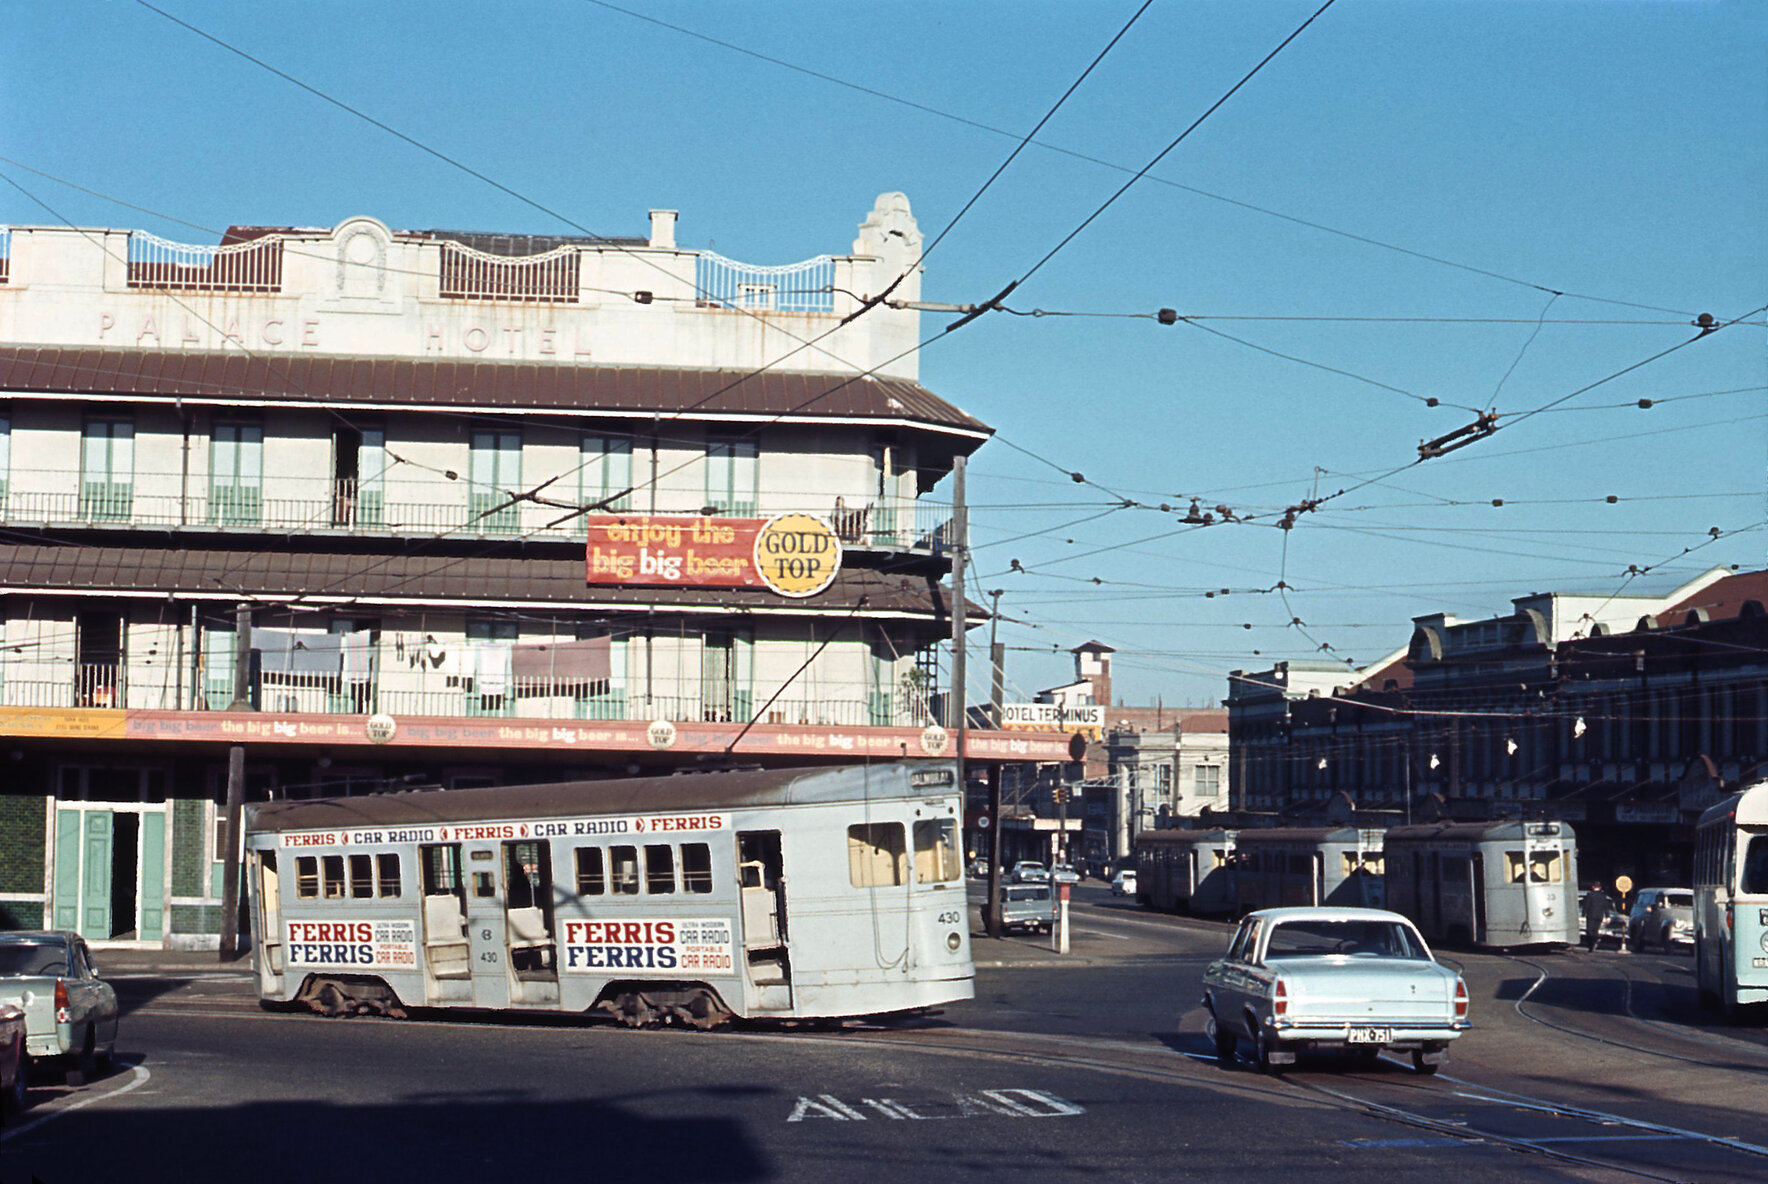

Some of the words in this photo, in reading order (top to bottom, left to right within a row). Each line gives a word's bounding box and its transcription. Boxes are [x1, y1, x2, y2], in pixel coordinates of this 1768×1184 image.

[99, 312, 321, 347] PALACE
[425, 321, 593, 357] HOTEL
[607, 517, 683, 547] enjoy
[692, 518, 735, 544] the
[765, 532, 830, 554] GOLD
[592, 547, 636, 578] big
[640, 548, 683, 580] big
[687, 549, 748, 577] beer
[775, 557, 822, 579] TOP
[1038, 707, 1099, 723] TERMINUS
[220, 721, 245, 734] the
[247, 722, 271, 736] big
[274, 722, 297, 738] big
[300, 722, 333, 736] beer
[499, 727, 523, 739] the
[525, 727, 549, 742] big
[552, 727, 576, 743] big
[578, 728, 612, 741] beer
[776, 733, 800, 746] the
[802, 733, 825, 749] big
[829, 734, 854, 749] big
[857, 735, 891, 747] beer
[991, 739, 1008, 753] big
[1010, 739, 1028, 754] big
[285, 833, 335, 847] FERRIS
[354, 832, 383, 844] CAR
[388, 829, 434, 843] RADIO
[455, 825, 514, 840] FERRIS
[534, 823, 568, 837] CAR
[575, 820, 628, 835] RADIO
[651, 815, 722, 832] FERRIS
[937, 911, 960, 924] 430
[288, 922, 373, 943] FERRIS
[375, 929, 390, 943] CAR
[391, 929, 414, 943] RADIO
[565, 922, 676, 945] FERRIS
[680, 929, 698, 944] CAR
[701, 929, 730, 944] RADIO
[290, 943, 375, 966] FERRIS
[481, 951, 498, 963] 430
[568, 945, 677, 969] FERRIS
[686, 945, 723, 953] PORTABLE
[376, 951, 391, 964] CAR
[393, 951, 415, 965] RADIO
[681, 954, 700, 969] CAR
[703, 954, 731, 969] RADIO
